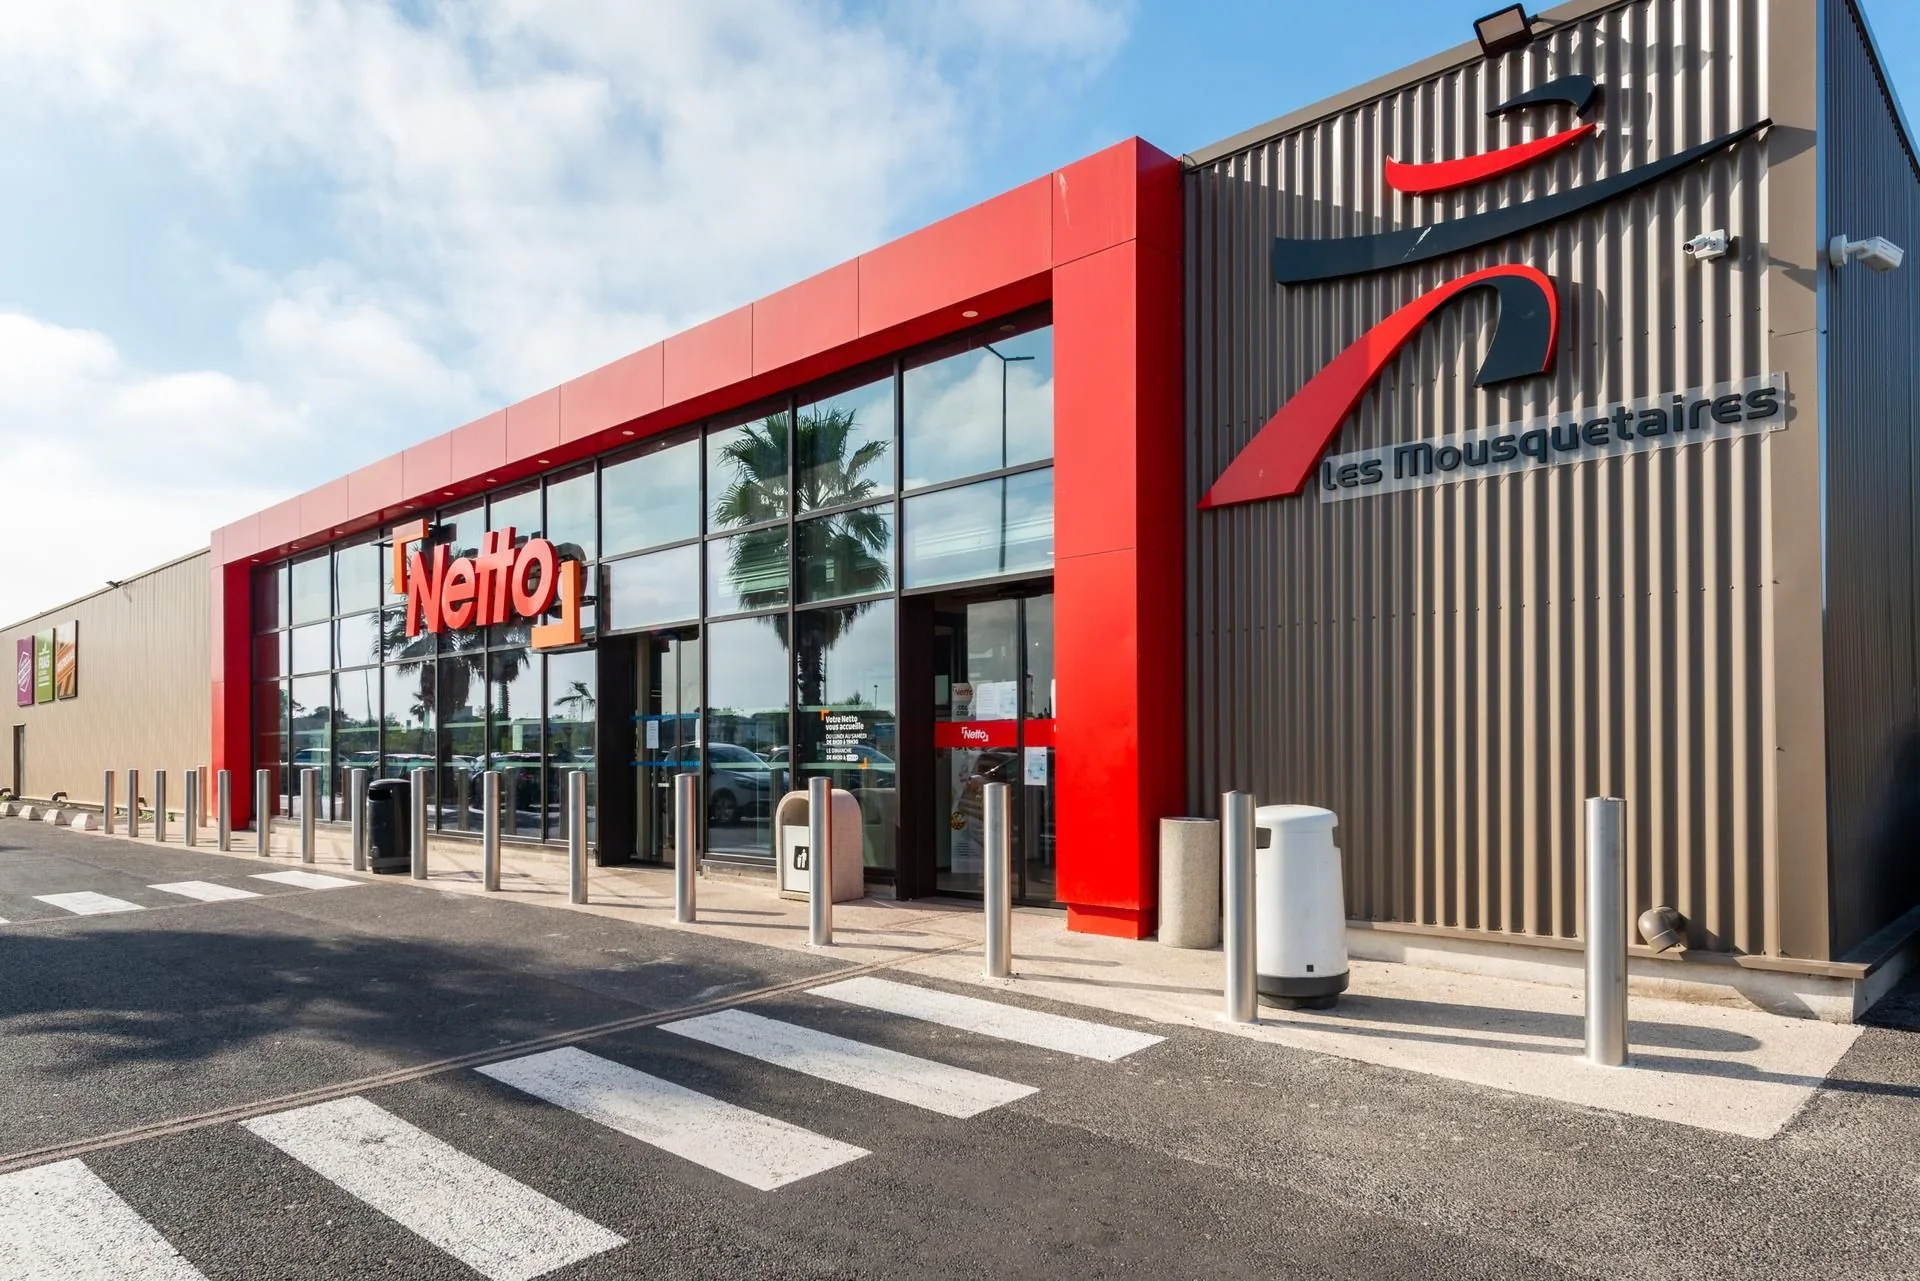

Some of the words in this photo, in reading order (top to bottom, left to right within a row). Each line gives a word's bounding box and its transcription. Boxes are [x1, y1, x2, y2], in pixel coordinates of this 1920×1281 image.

[1393, 386, 1779, 480] Mousquetaires
[405, 526, 559, 638] Netto
[825, 715, 841, 723] Votre
[841, 715, 858, 723] Netto
[840, 722, 865, 730] accueille
[963, 728, 987, 739] Netto
